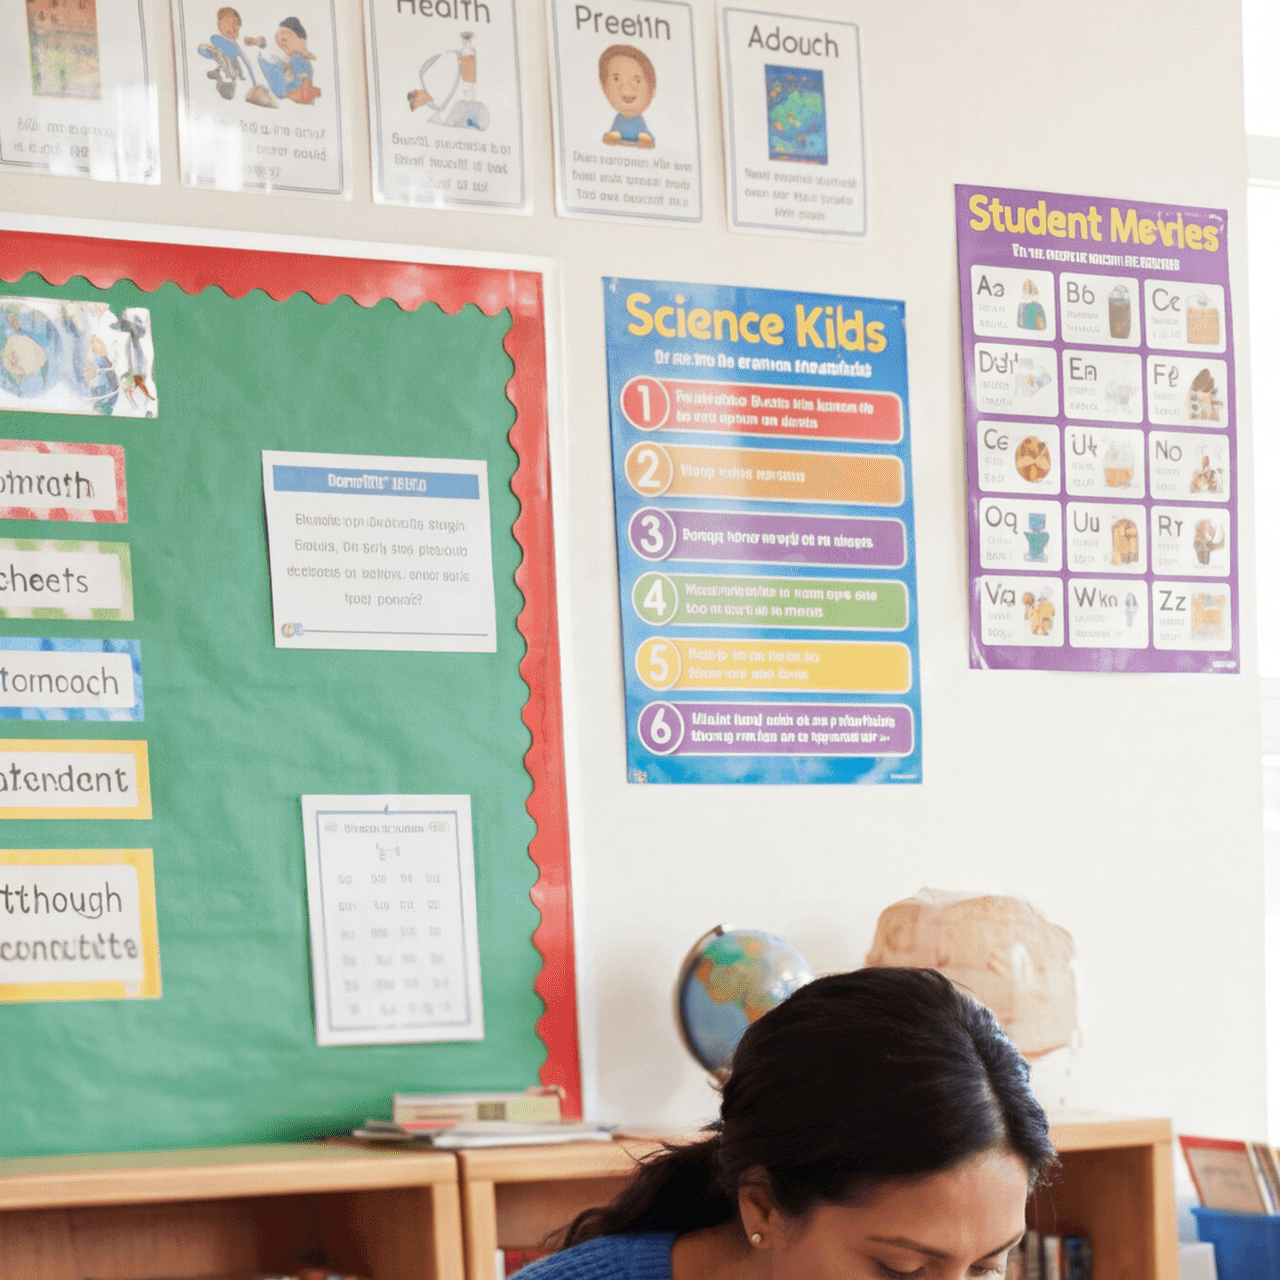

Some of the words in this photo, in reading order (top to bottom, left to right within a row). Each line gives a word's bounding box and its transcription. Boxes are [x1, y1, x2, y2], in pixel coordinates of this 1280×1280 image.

[396, 0, 491, 24] Health
[748, 24, 839, 58] Adouch
[969, 194, 1103, 242] Student
[625, 292, 785, 346] Science
[796, 303, 887, 354] Kids
[636, 384, 651, 422] 1
[636, 449, 662, 488] 2
[640, 515, 665, 553] 3
[642, 578, 667, 616] 4
[1158, 589, 1188, 612] Zz
[648, 644, 671, 682] 5
[650, 707, 672, 744] 6
